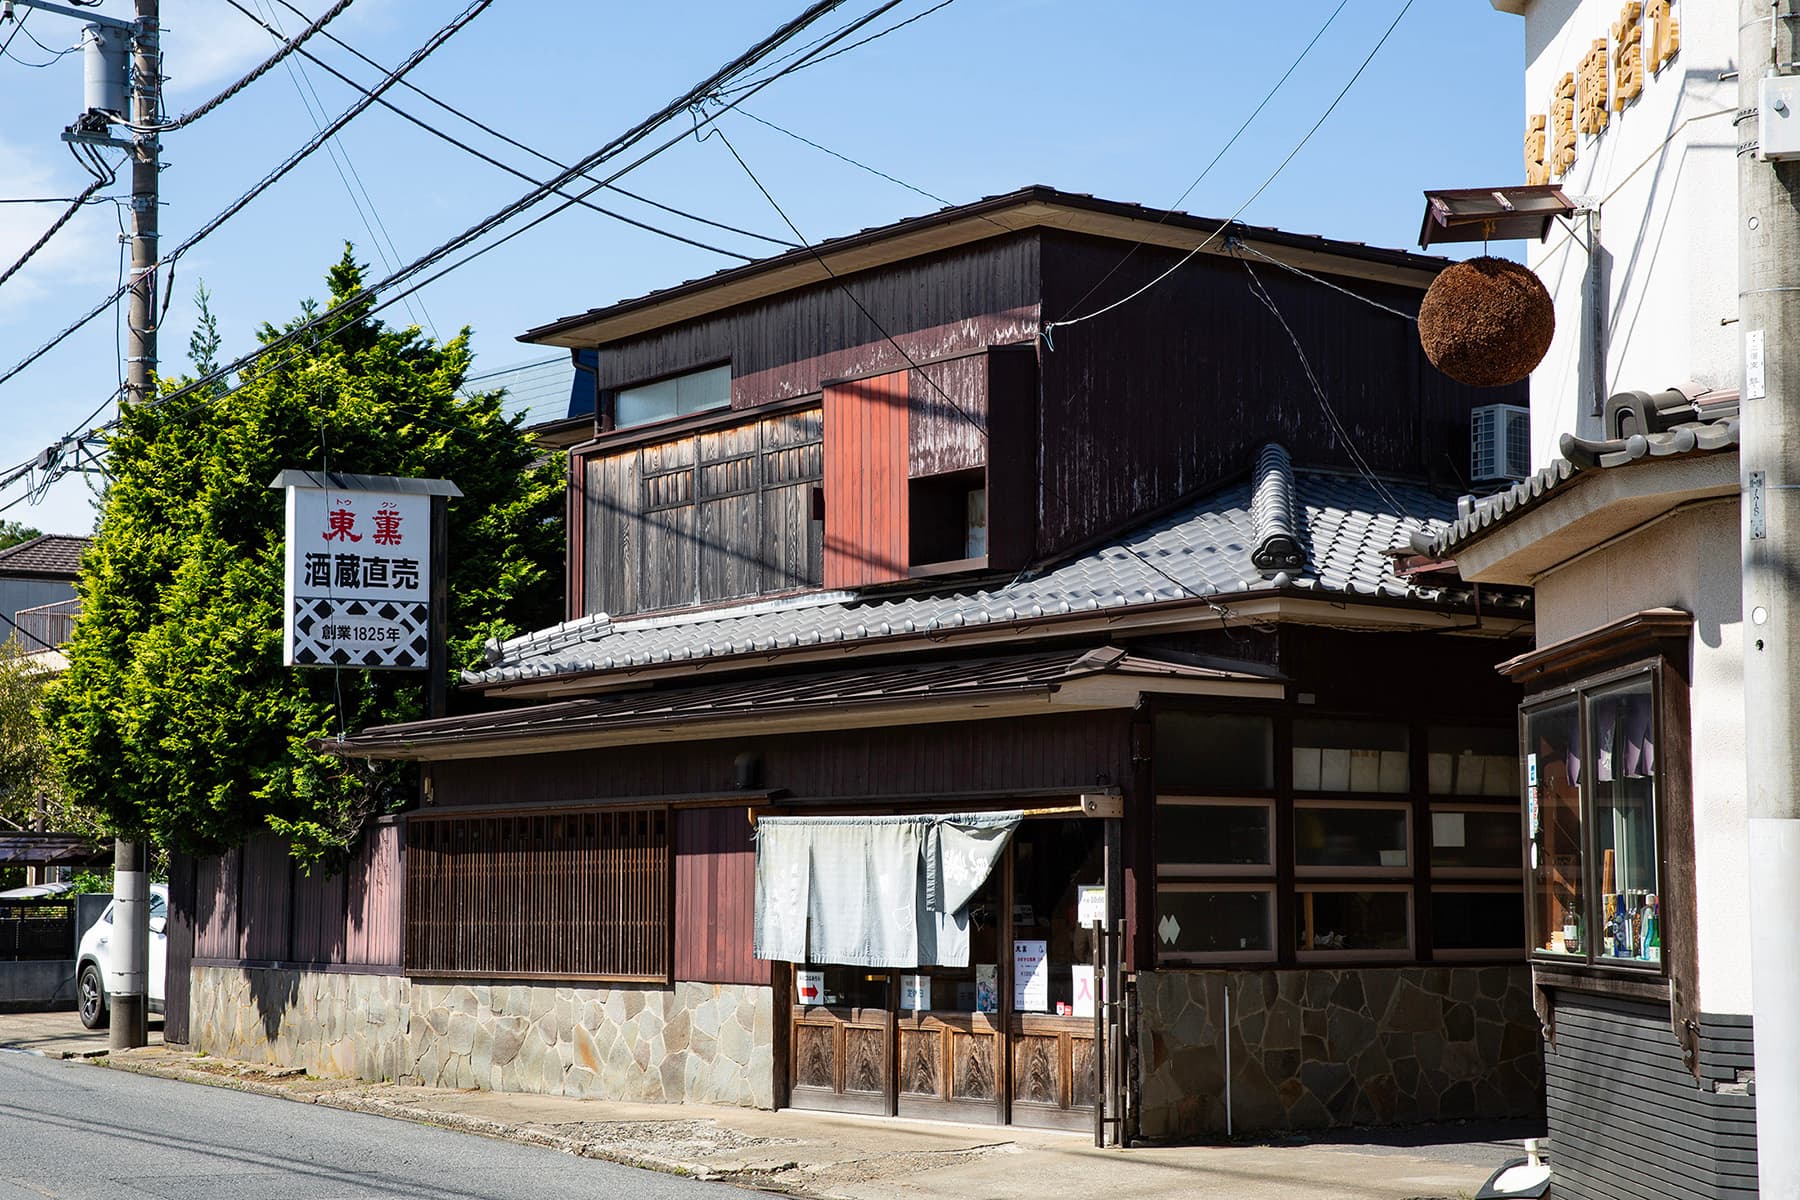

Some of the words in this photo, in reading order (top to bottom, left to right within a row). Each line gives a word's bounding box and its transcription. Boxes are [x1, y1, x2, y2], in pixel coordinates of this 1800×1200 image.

[336, 498, 352, 506] トウ
[381, 501, 397, 509] クン
[322, 509, 403, 546] 東薫
[304, 552, 419, 590] 酒蔵直売
[321, 624, 401, 643] 創業1825年
